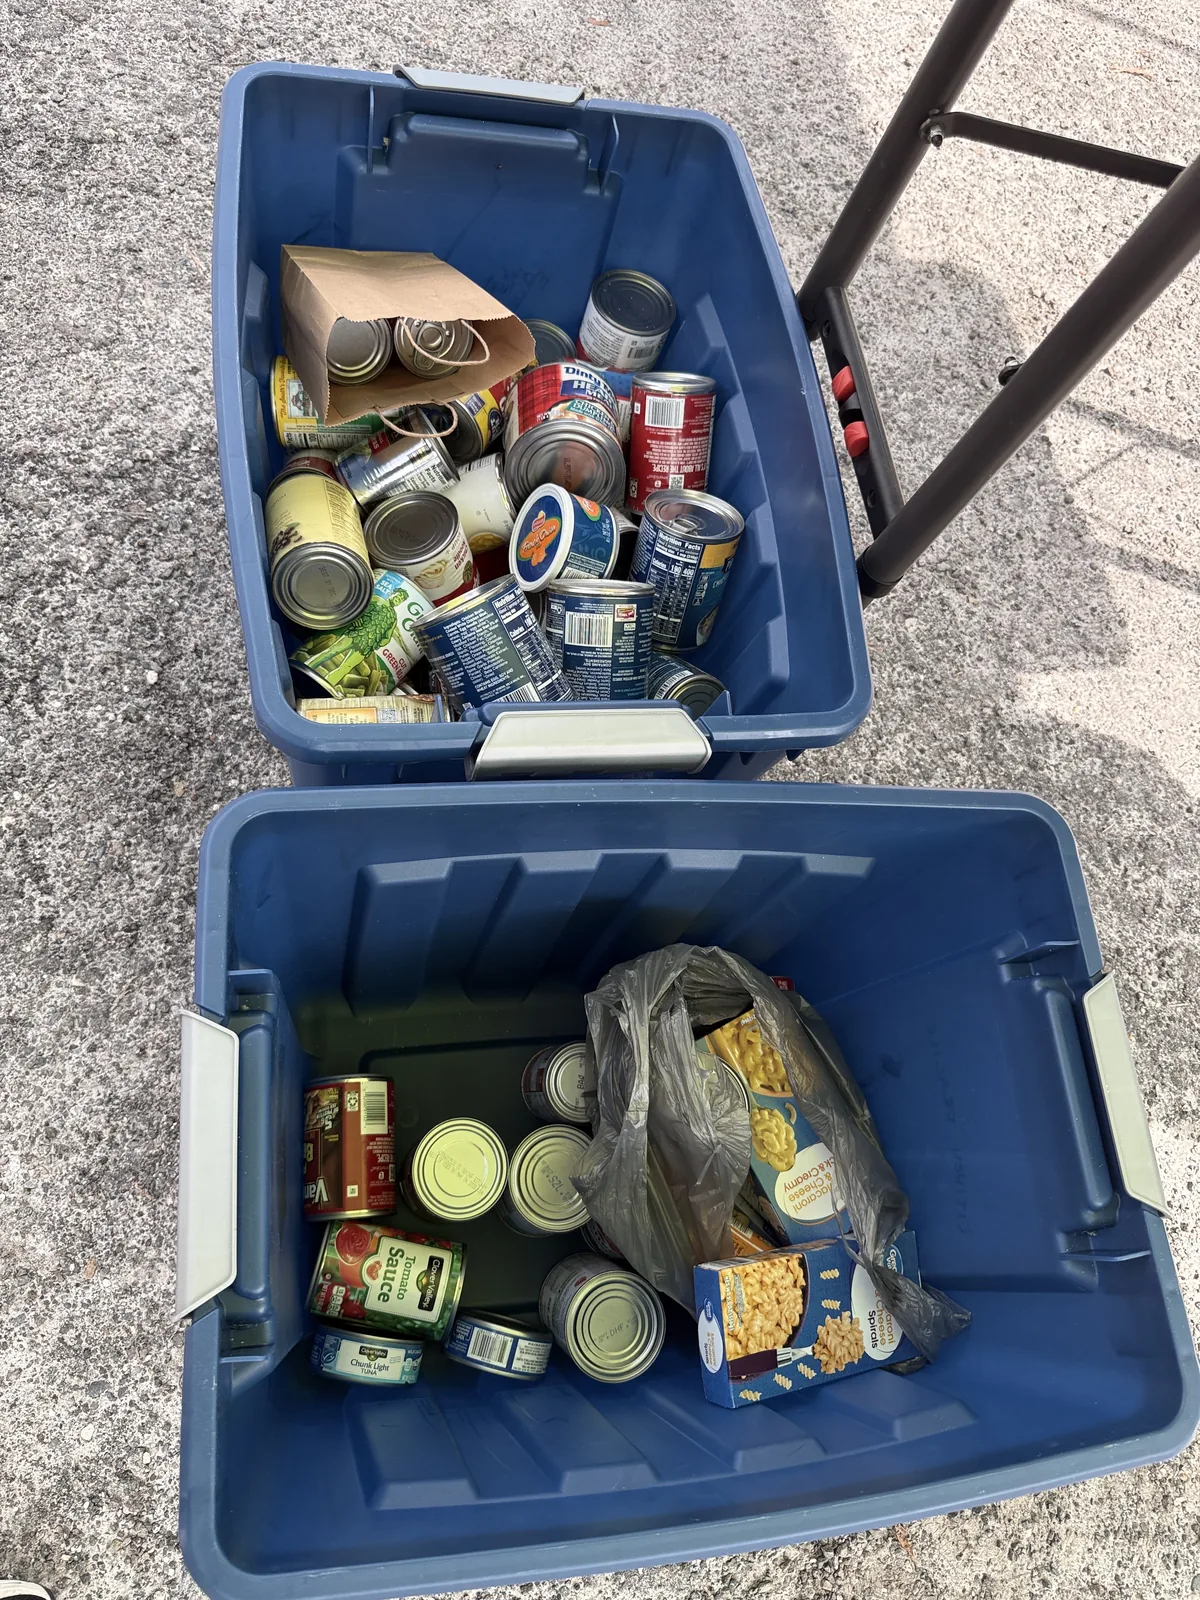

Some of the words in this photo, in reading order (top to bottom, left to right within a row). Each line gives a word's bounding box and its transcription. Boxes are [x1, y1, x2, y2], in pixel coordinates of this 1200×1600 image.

[564, 366, 601, 387] Dinty
[658, 531, 681, 547] Nutrition
[684, 543, 701, 551] Facts
[375, 583, 391, 594] SALT
[380, 580, 393, 589] SEA
[494, 593, 516, 609] Nutrition
[382, 648, 401, 673] GREEN
[398, 658, 407, 669] CUT
[784, 1167, 819, 1192] Creamy
[824, 1172, 832, 1181] &
[789, 1177, 824, 1201] Cheese
[889, 1249, 898, 1272] Grea
[378, 1246, 405, 1303] Sauce
[397, 1256, 416, 1300] Tomato
[867, 1310, 879, 1349] Spirals
[876, 1299, 886, 1346] Cheese
[886, 1311, 897, 1344] aroni
[350, 1359, 373, 1370] Chunk
[373, 1362, 390, 1372] Light
[361, 1368, 377, 1376] TUNA
